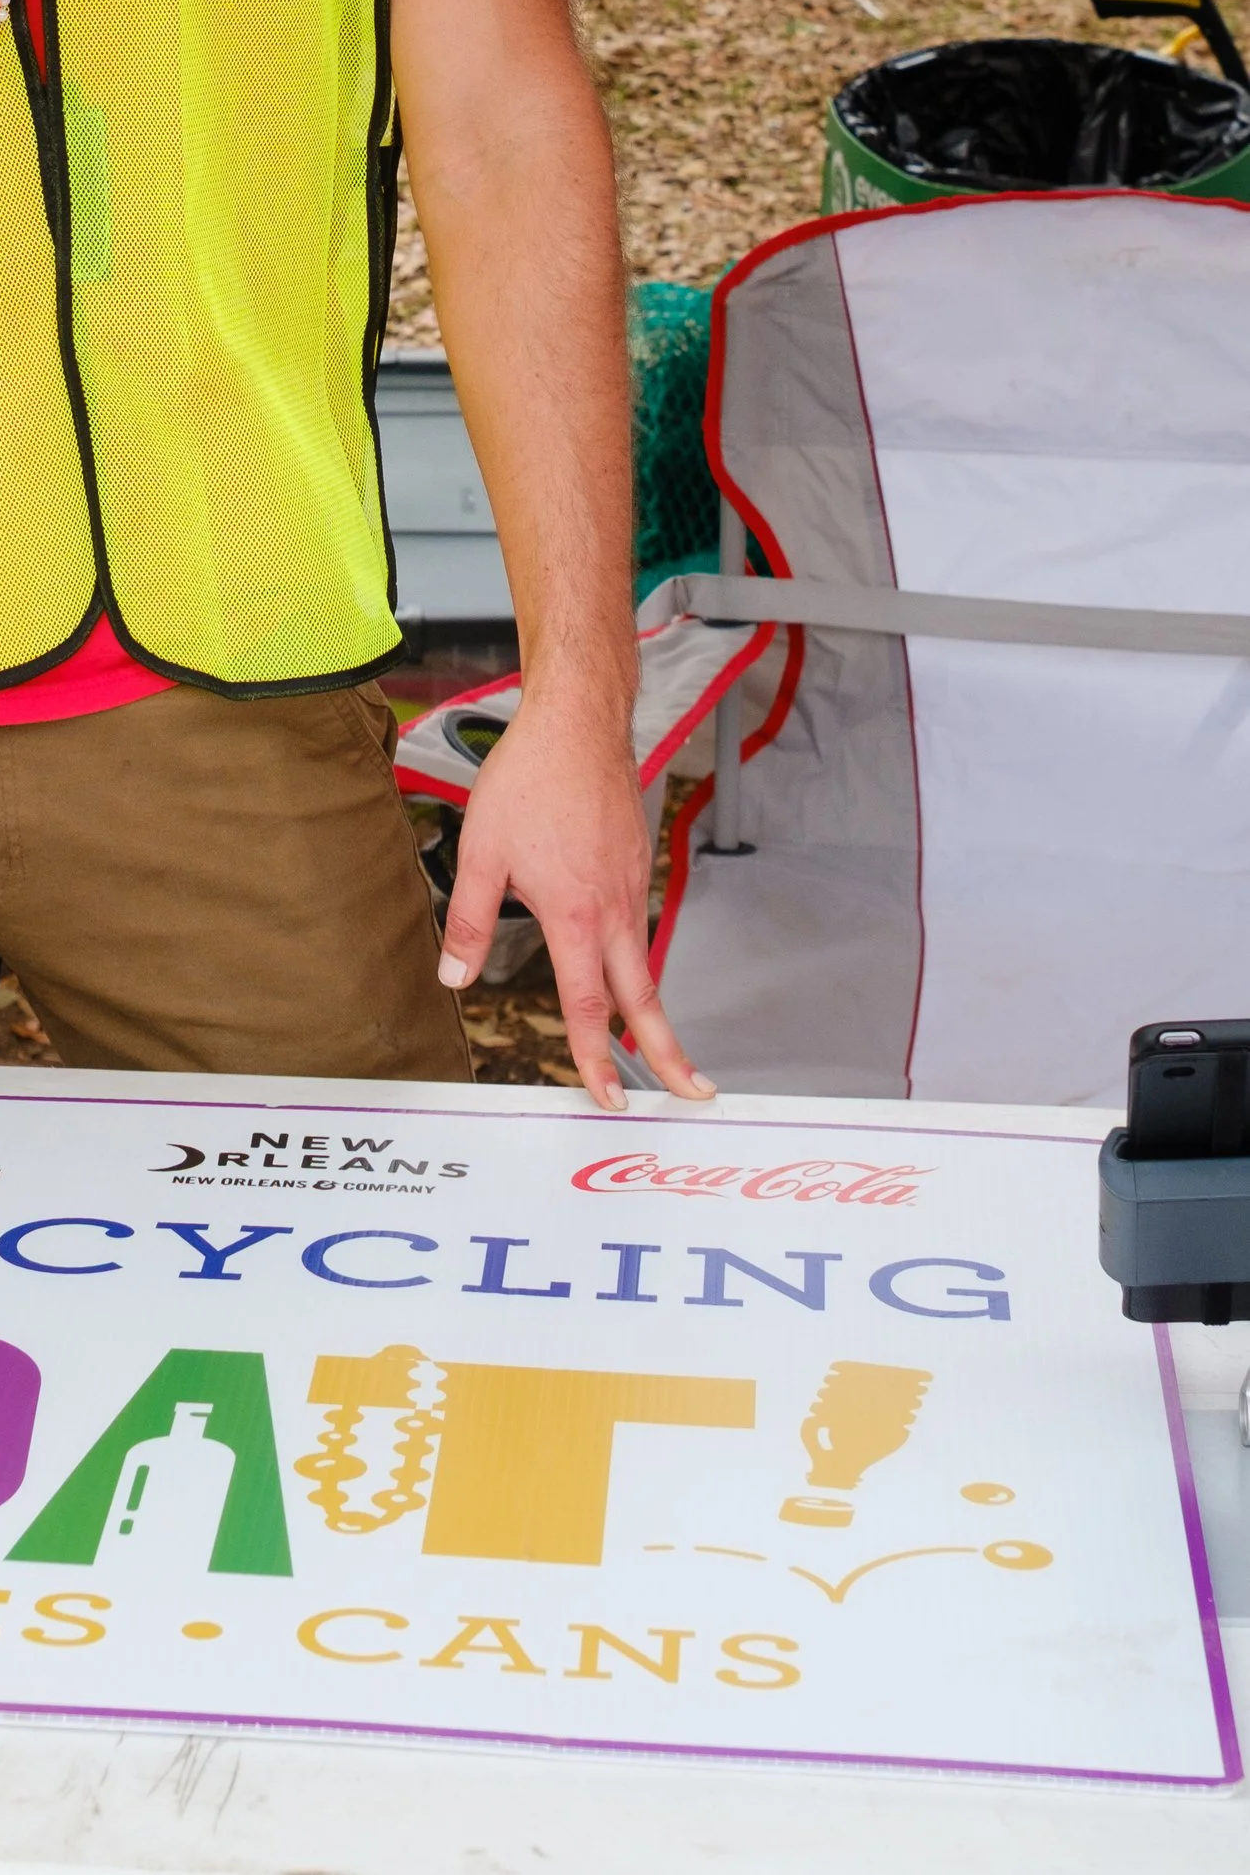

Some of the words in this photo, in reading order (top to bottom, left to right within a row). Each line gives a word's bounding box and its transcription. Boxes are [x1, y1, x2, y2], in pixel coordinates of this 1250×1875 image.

[249, 1132, 395, 1154] NEW
[171, 1175, 215, 1186] NEW
[221, 1176, 307, 1190] ORLEANS
[343, 1181, 437, 1195] COMPANY
[570, 1152, 938, 1207] Coca-Cola
[296, 1608, 802, 1691] CANS
